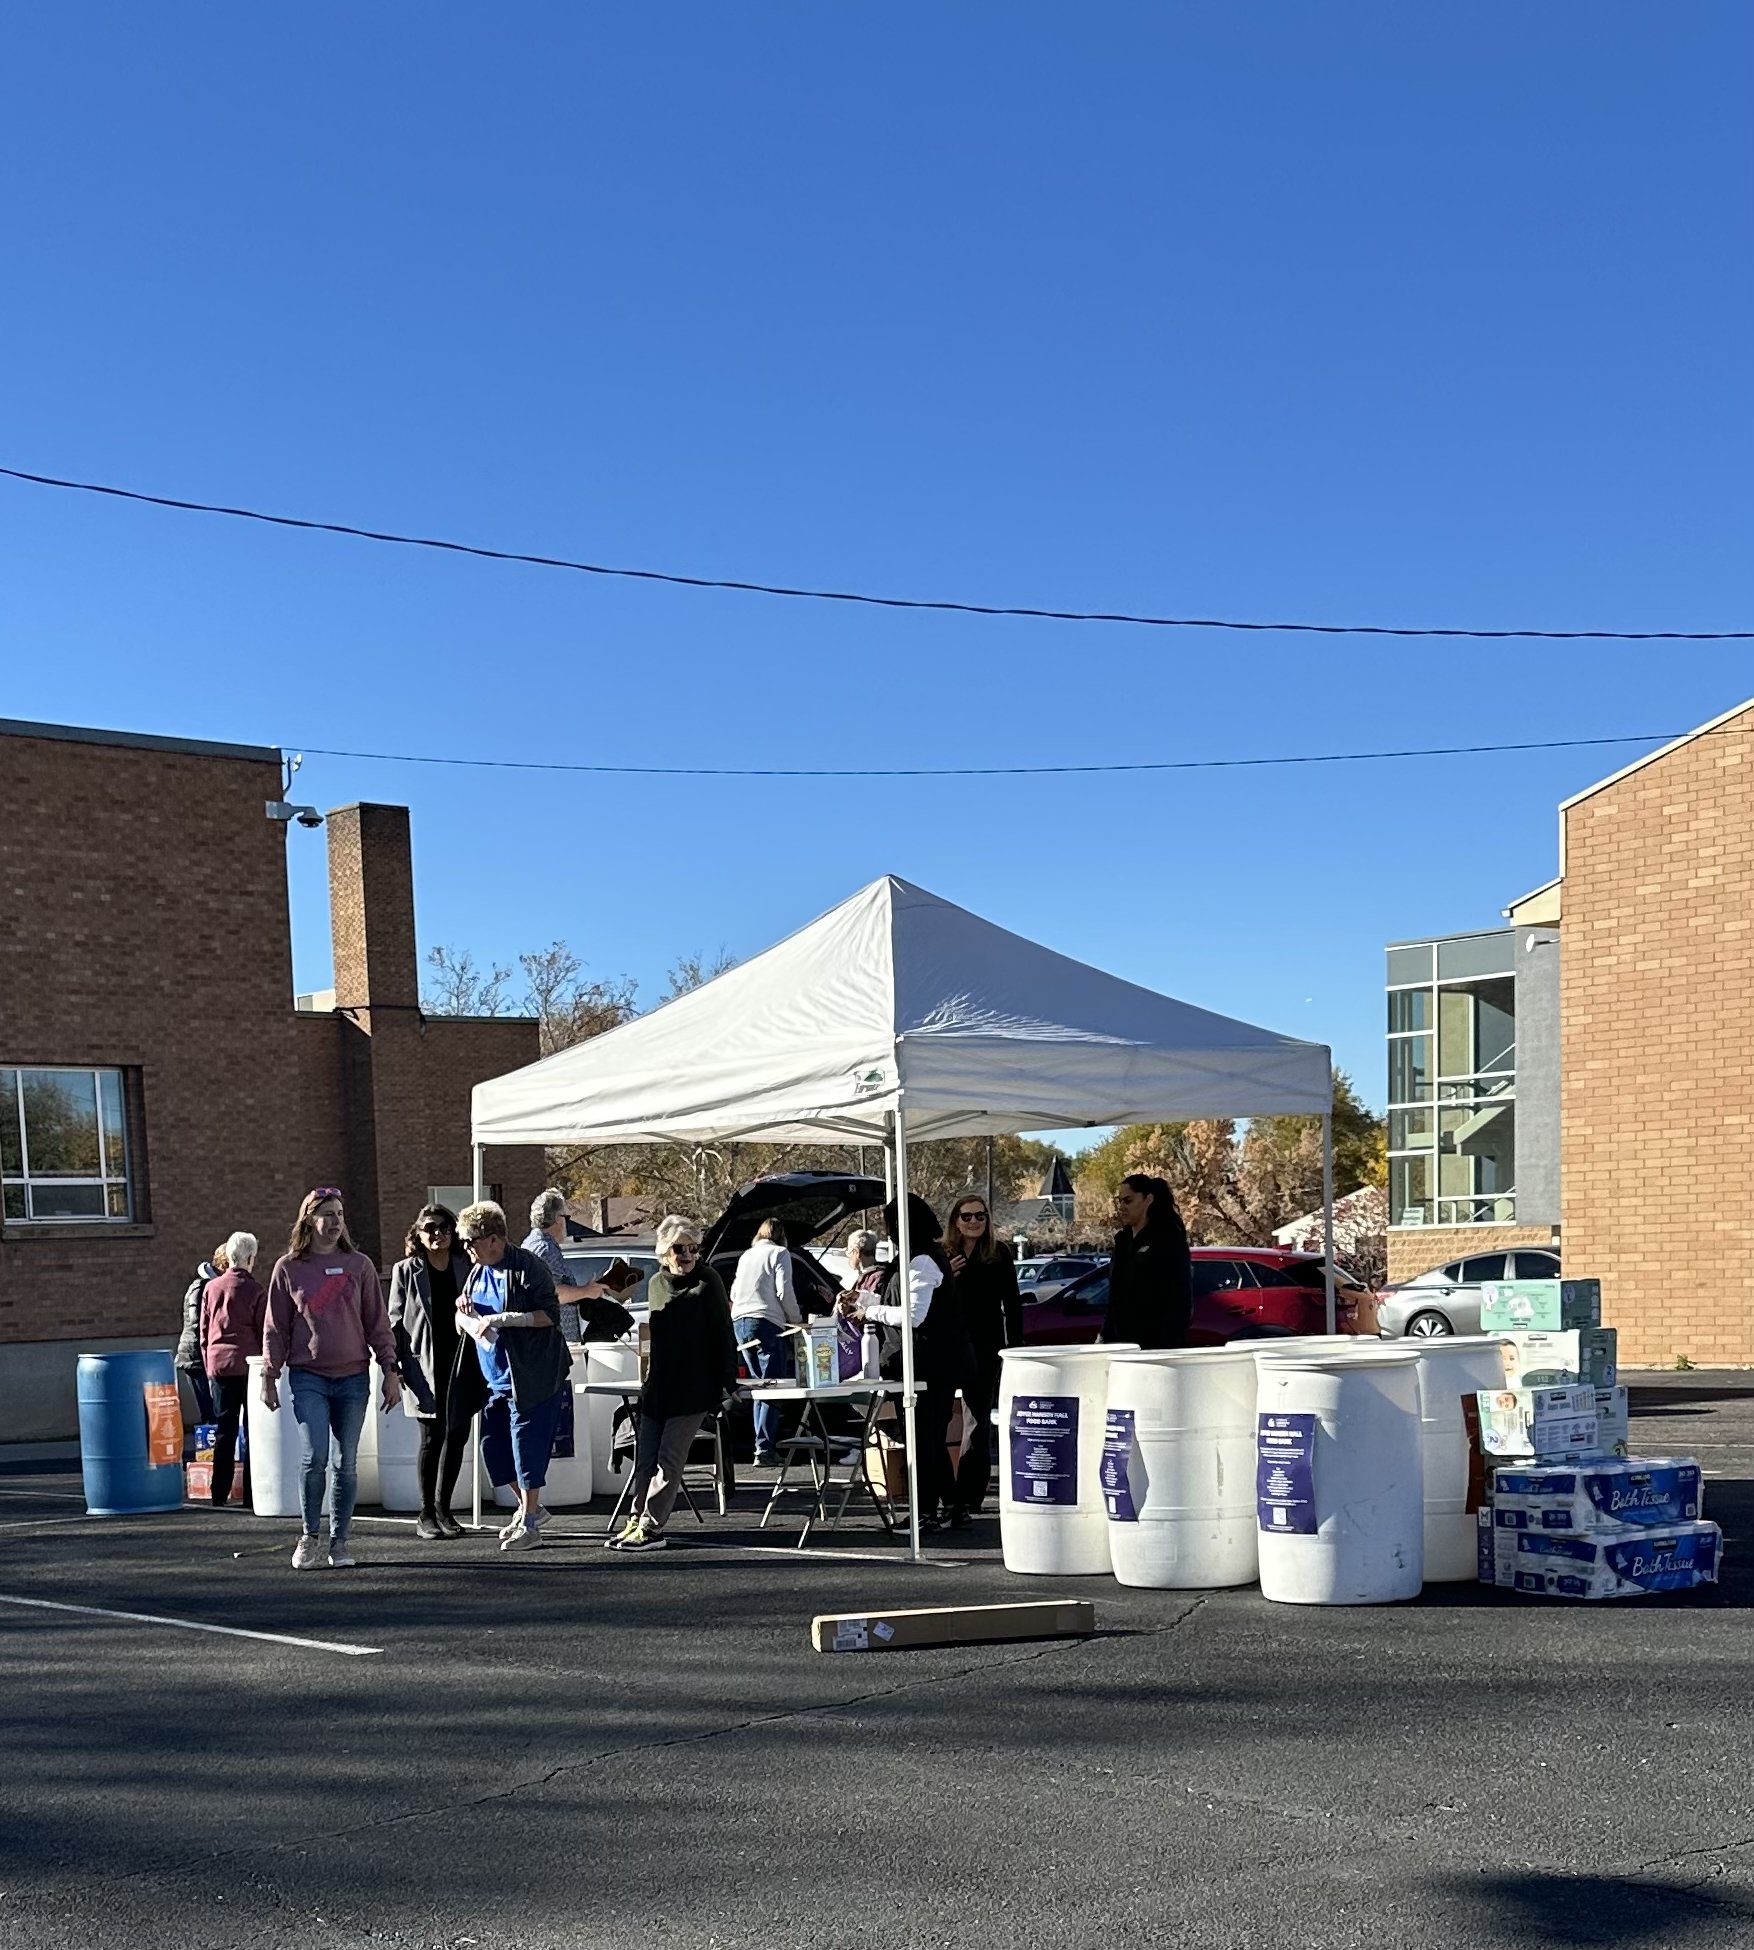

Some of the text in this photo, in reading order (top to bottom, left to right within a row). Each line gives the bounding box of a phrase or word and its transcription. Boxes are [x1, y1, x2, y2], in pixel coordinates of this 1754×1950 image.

[1610, 1487, 1671, 1510] Bath Tissue
[1632, 1553, 1694, 1577] Bath Tissue
